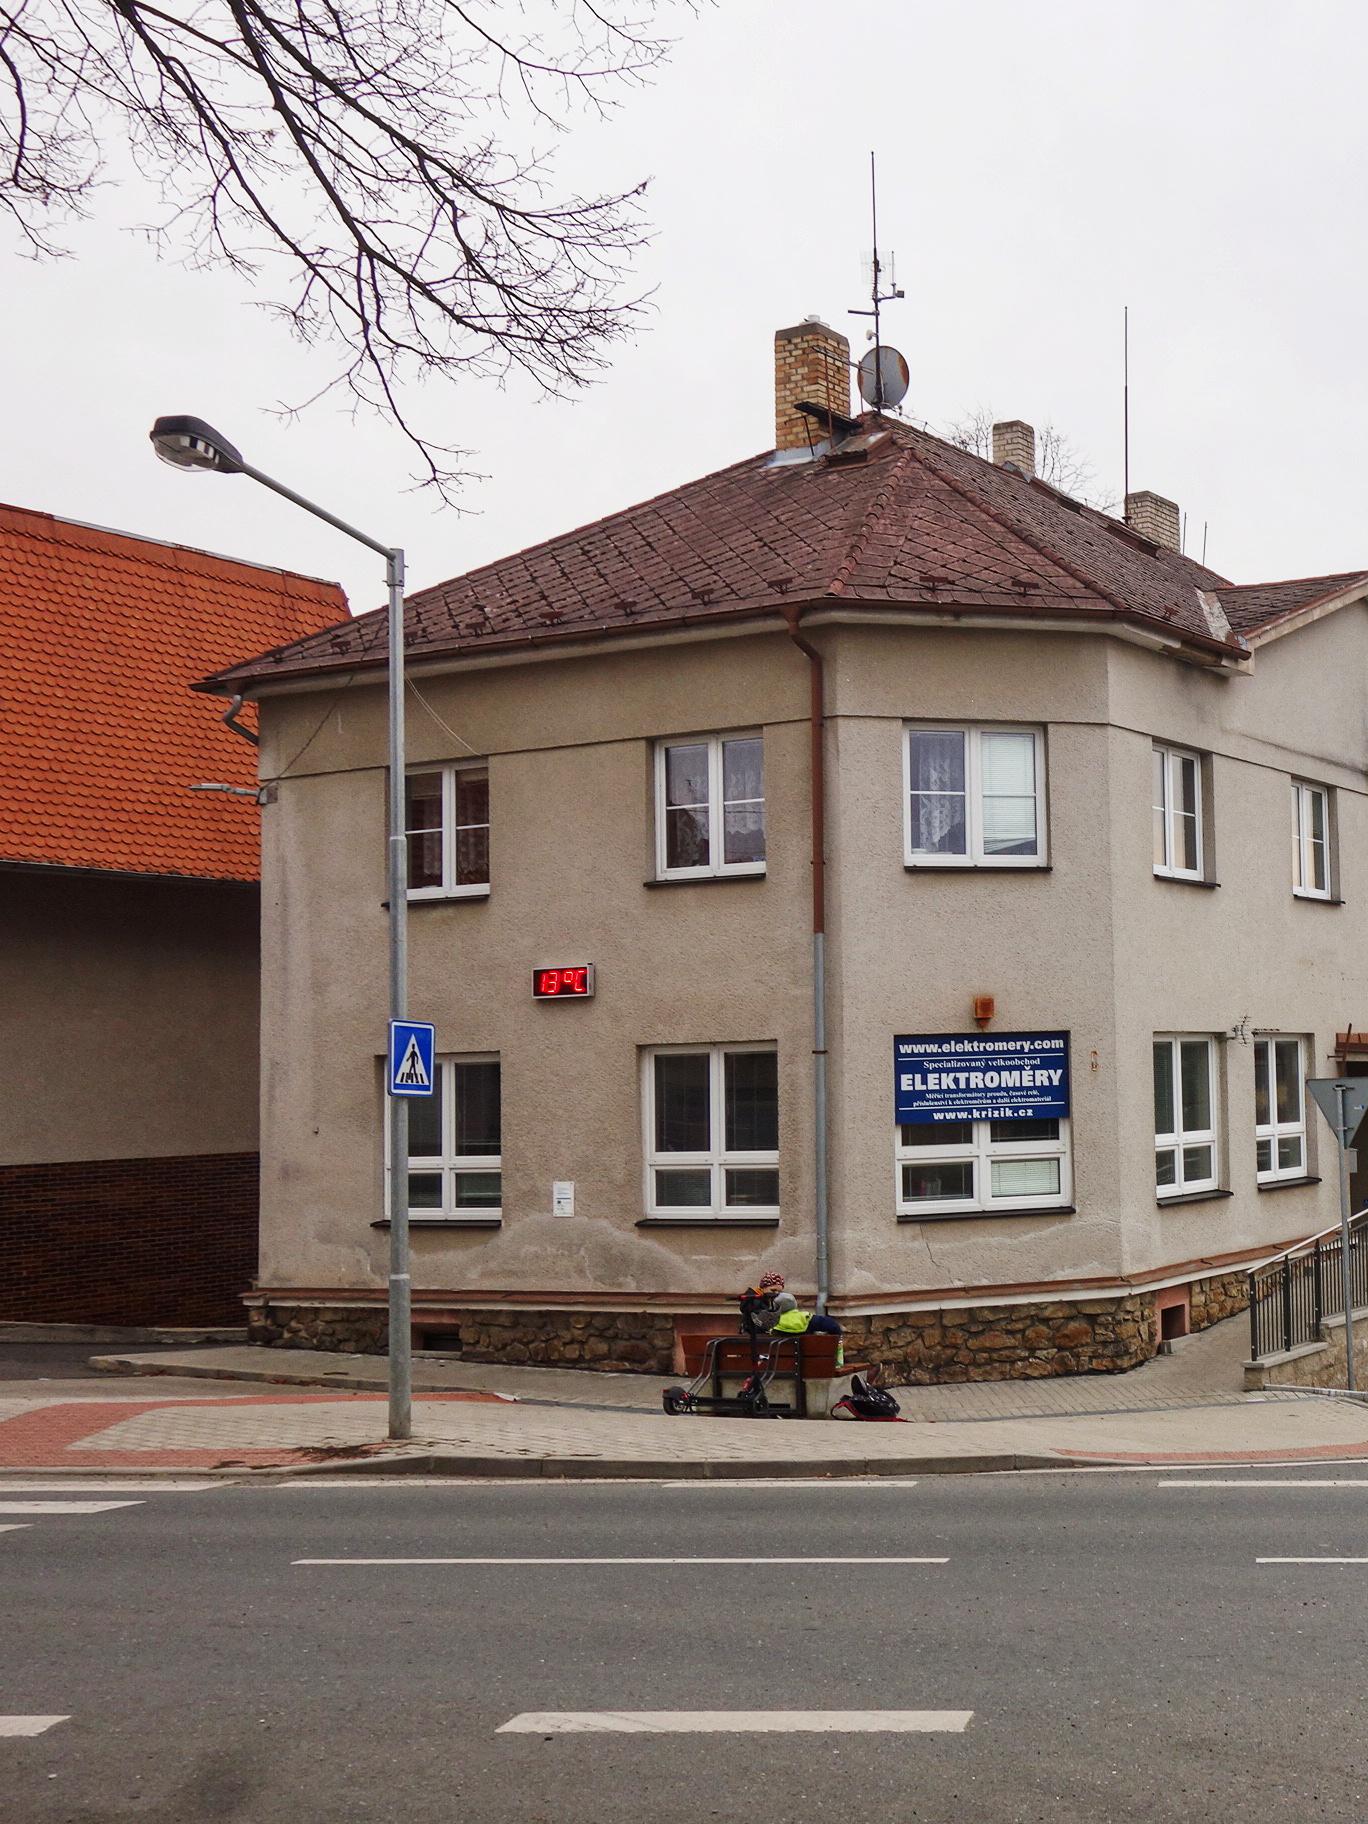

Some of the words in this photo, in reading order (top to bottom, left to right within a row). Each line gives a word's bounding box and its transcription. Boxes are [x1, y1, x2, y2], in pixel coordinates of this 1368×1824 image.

[899, 1039, 1064, 1053] www.elektromery.com
[923, 1059, 986, 1070] Specializovaný
[988, 1058, 1041, 1068] velkoobchod
[900, 1066, 1063, 1091] ELEKTROMĚRY
[932, 1108, 1034, 1120] www.krizik.cz
